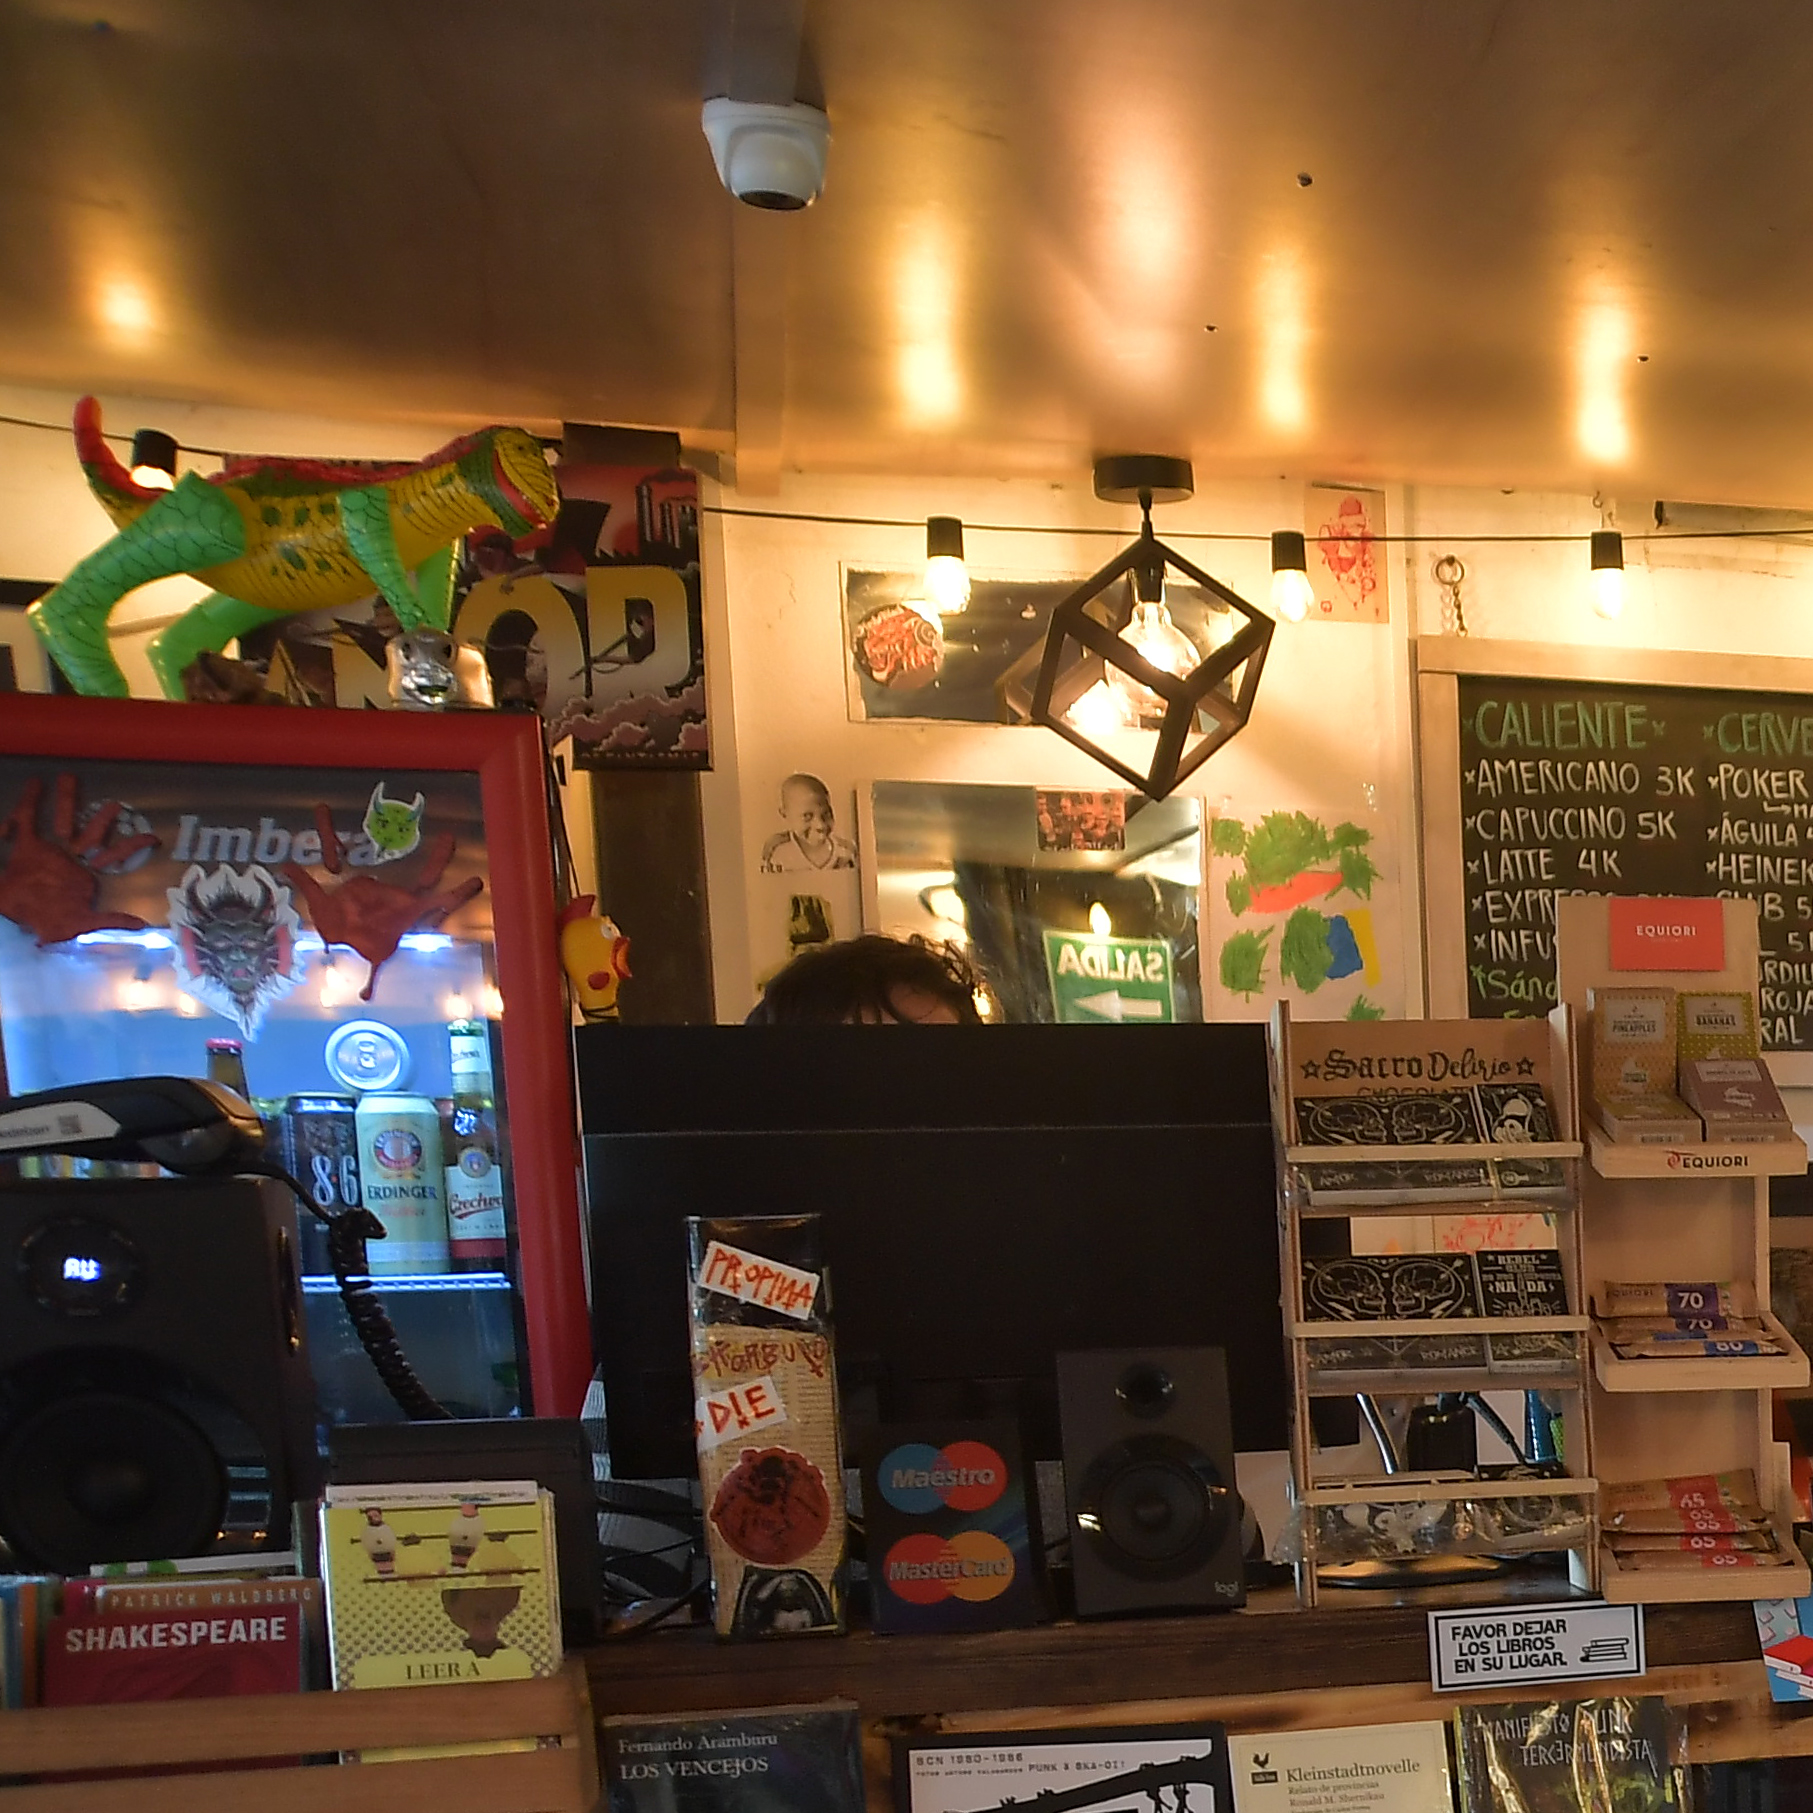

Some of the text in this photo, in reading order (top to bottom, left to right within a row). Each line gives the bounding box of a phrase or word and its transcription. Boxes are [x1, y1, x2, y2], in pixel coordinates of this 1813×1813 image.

[1475, 700, 1648, 750] CALIENTE
[1477, 759, 1695, 798] AMERICANO 3K
[1719, 764, 1809, 800] POKER
[1477, 806, 1677, 842] CAPUCCINO 5K
[1483, 848, 1555, 886] LATTE
[1636, 925, 1697, 937] EQUIORI
[1682, 1154, 1749, 1170] EQUIORI
[368, 1184, 438, 1200] ERDINGER
[1677, 1291, 1704, 1310] 70
[891, 1465, 995, 1489] Maestro
[889, 1557, 1008, 1584] MasterCard
[1214, 1581, 1239, 1597] logi
[65, 1617, 287, 1653] SHAKESPEARE
[1451, 1619, 1566, 1641] FAVOR DEJAR
[1458, 1637, 1554, 1657] LOS LIBROS
[406, 1662, 457, 1681] LEER
[1454, 1657, 1503, 1674] EN SU
[618, 1733, 778, 1754] Fernando Aramburu
[620, 1756, 769, 1781] LOS VENCEJOS
[1286, 1758, 1420, 1783] Kleinstadtnovelle
